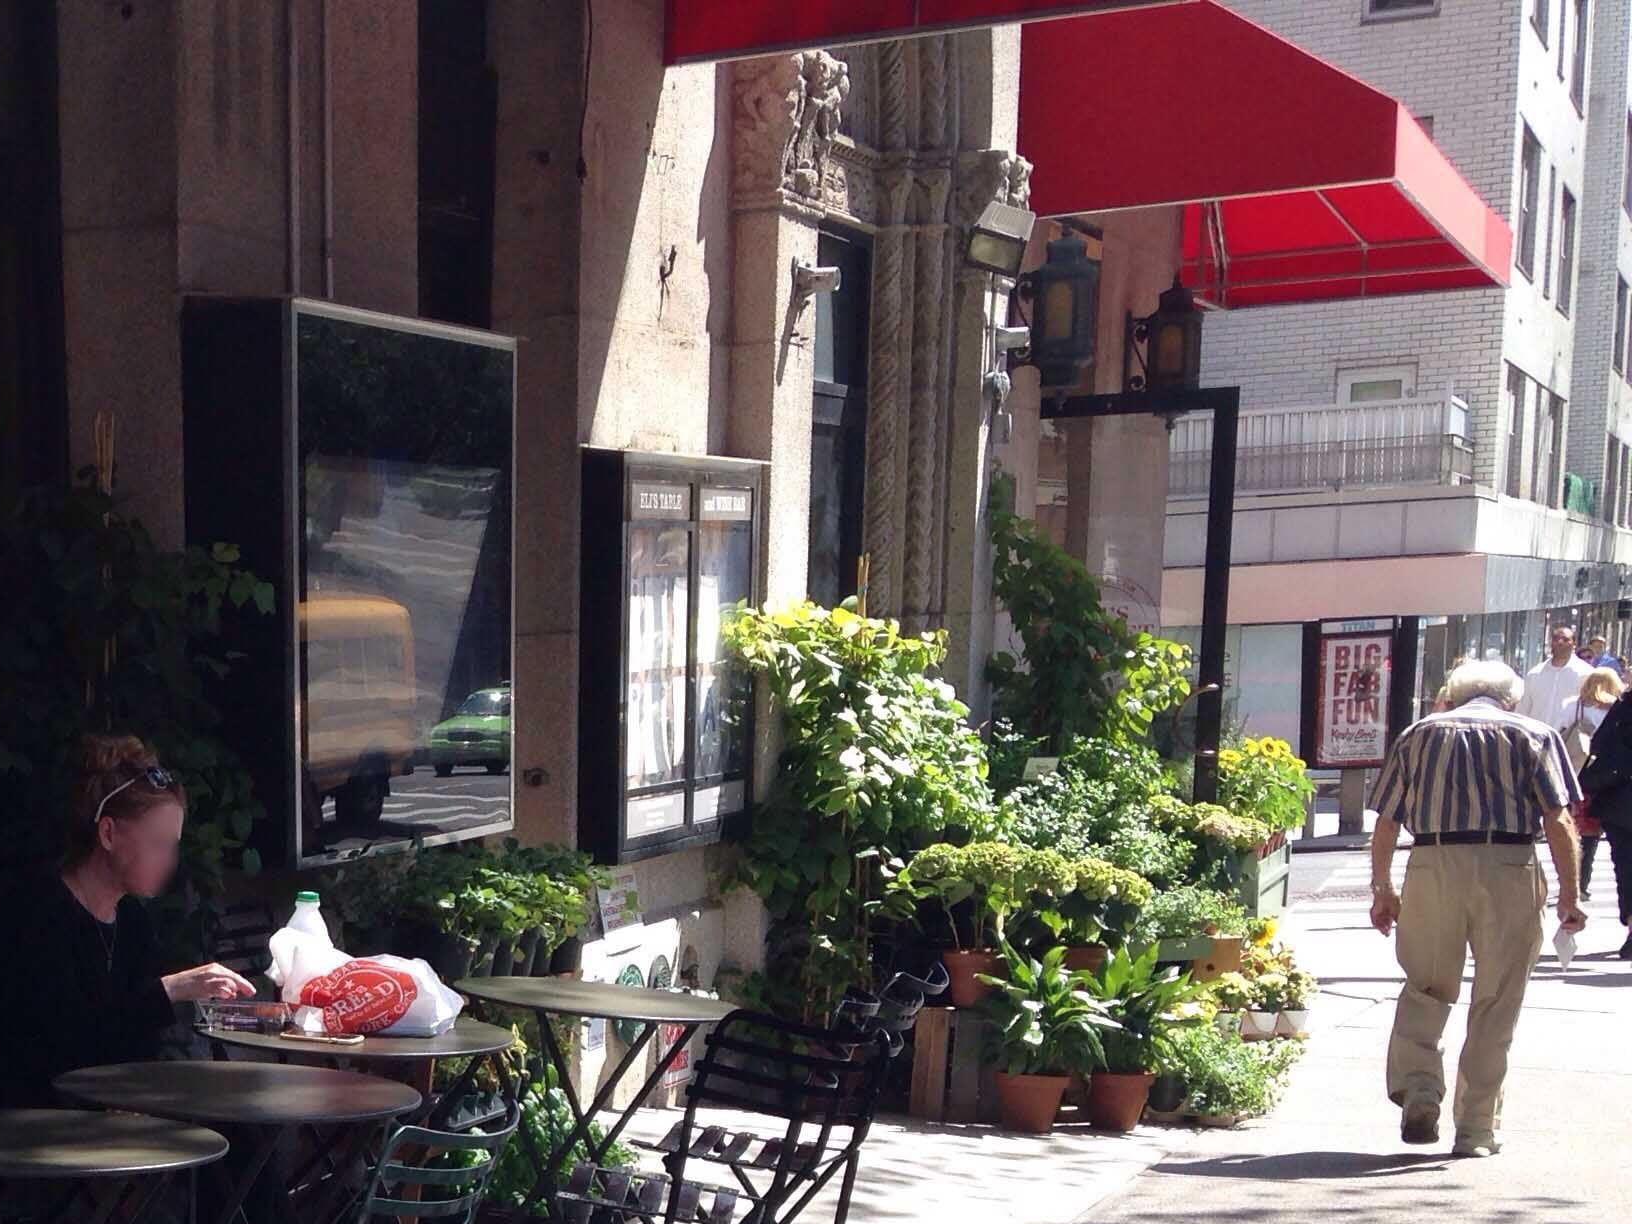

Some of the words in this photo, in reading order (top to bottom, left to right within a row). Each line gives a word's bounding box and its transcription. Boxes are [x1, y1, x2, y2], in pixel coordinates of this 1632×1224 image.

[639, 492, 658, 509] ELI'S
[659, 493, 683, 510] TABLE
[1335, 643, 1382, 670] BIG
[1333, 670, 1381, 697] FAB
[1332, 697, 1380, 725] FUN
